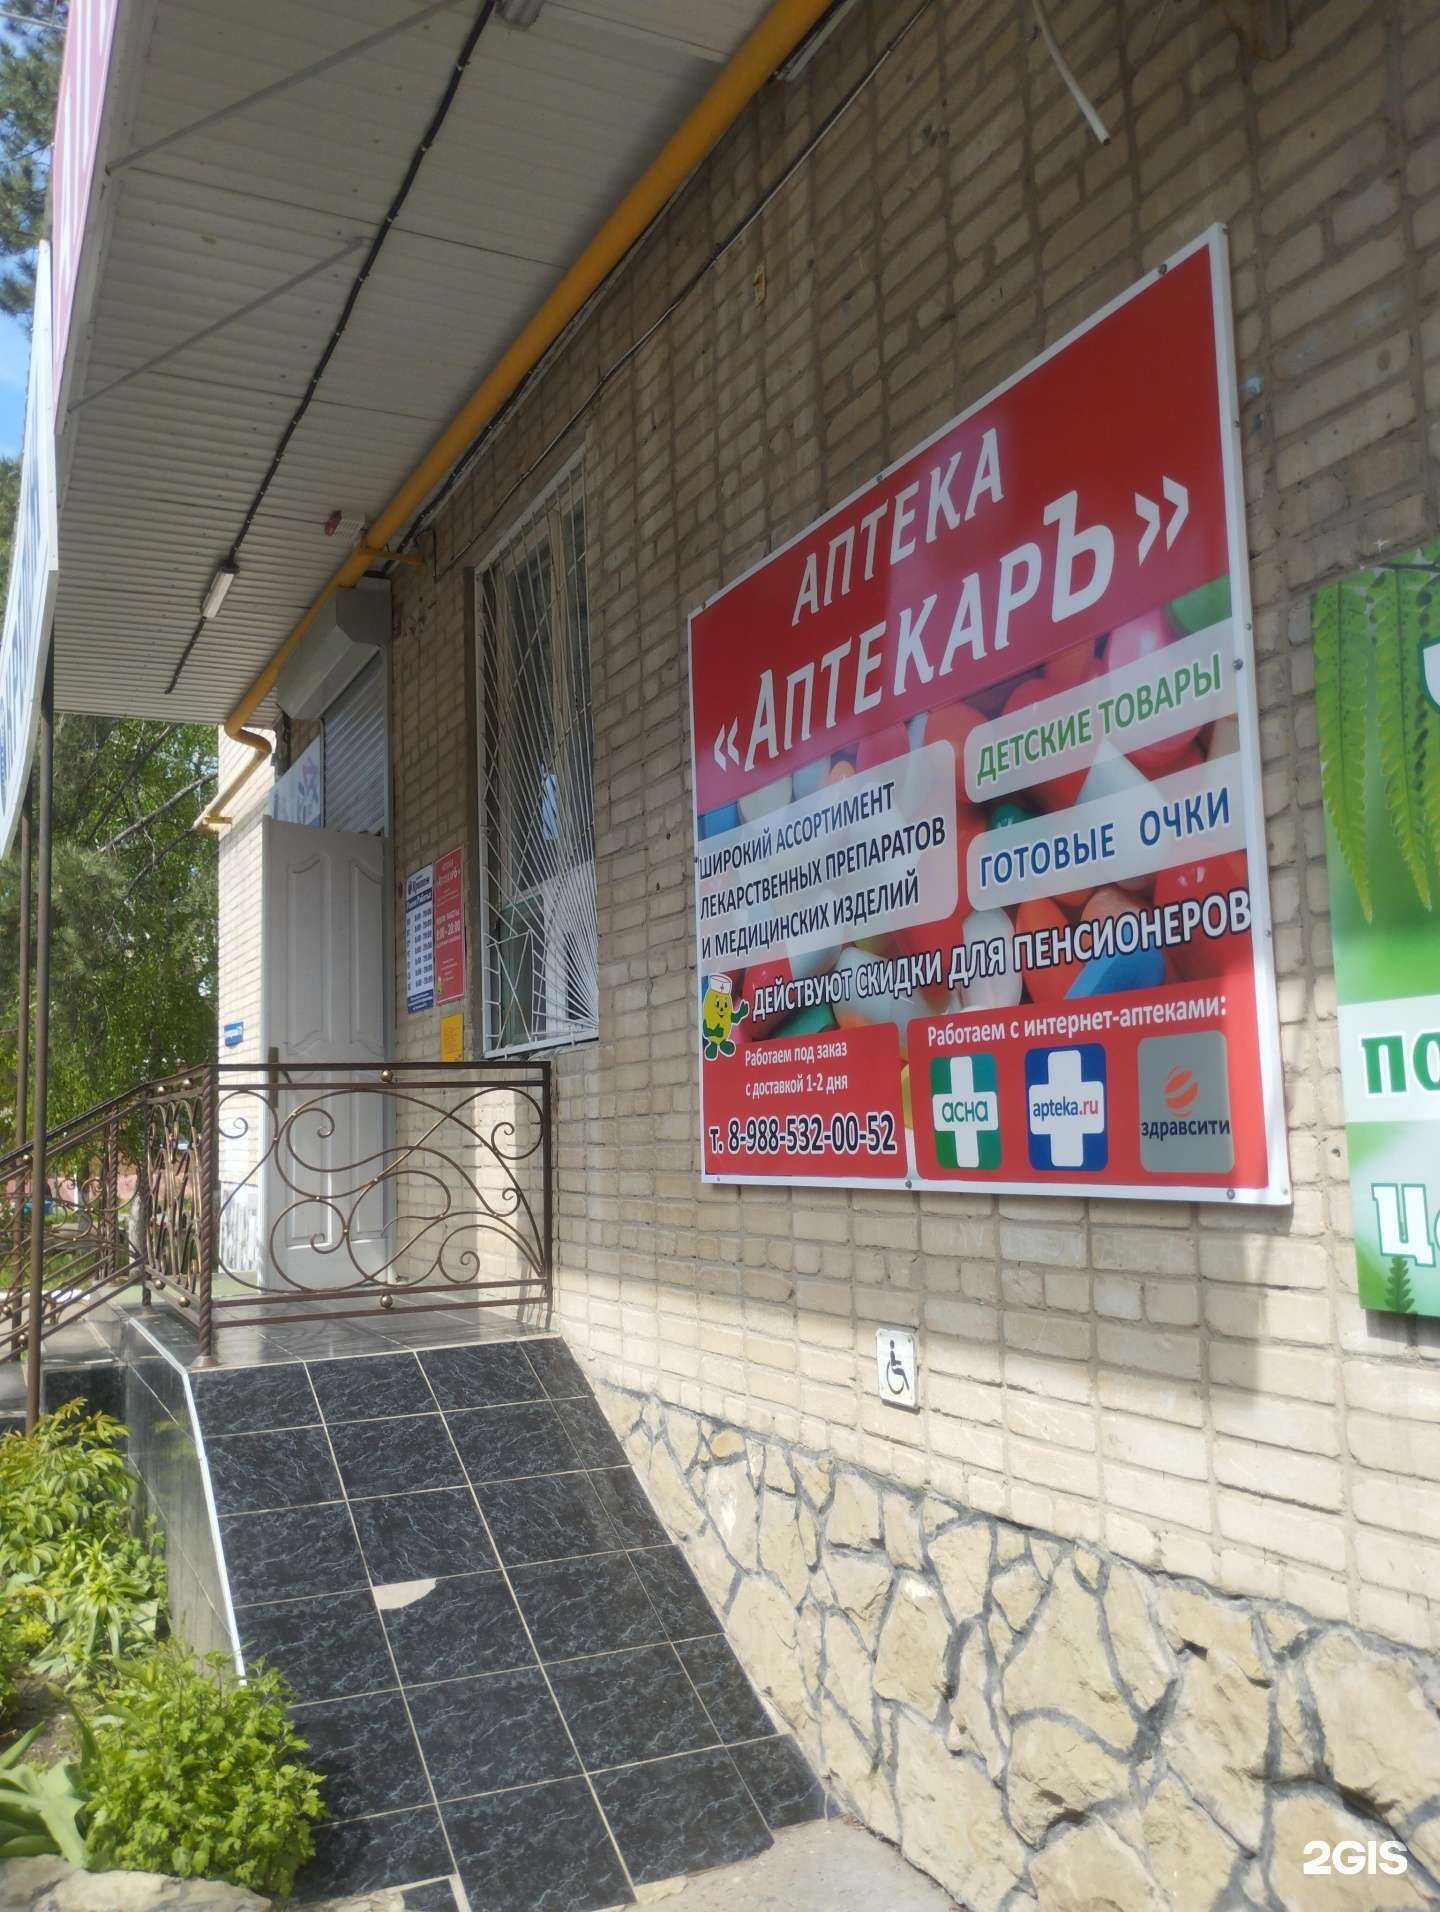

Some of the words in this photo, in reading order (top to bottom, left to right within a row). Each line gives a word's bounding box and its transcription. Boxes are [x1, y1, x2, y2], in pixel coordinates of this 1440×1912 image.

[791, 426, 1005, 627] АПТЕКА
[976, 708, 1093, 786] ДЕТСКИЕ
[1098, 653, 1221, 735] ТОВАРЫ
[699, 826, 773, 880] ШИРОКИЙ
[776, 781, 895, 853] АССОРТИМЕНТ
[979, 822, 1115, 889] ГОТОВЫЕ
[1139, 787, 1230, 847] ОЧКИ
[700, 858, 822, 920] ЛЕКАРСТВЕННЫХ
[825, 816, 946, 881] ПРЕПАРАТОВ
[702, 936, 712, 960] И
[715, 903, 830, 958] МЕДИЦИНСКИХ
[833, 868, 920, 930] ИЗДЕЛИЙ
[752, 968, 853, 1022] ДЕЙСТВУЮТ
[855, 949, 943, 998] СКИДКИ
[948, 937, 1006, 990] ДЛЯ
[1012, 888, 1252, 972] ПЕНСИОНЕРОВ
[745, 1047, 792, 1067] Работаем
[794, 1046, 814, 1063] под
[816, 1041, 848, 1058] заказ
[927, 1025, 1005, 1047] Работаем
[1010, 1022, 1020, 1039] с
[1024, 995, 1227, 1038] интернет-аптеками:
[745, 1084, 752, 1097] с
[752, 1075, 804, 1099] доставкой
[806, 1073, 824, 1092] 1-2
[826, 1075, 848, 1095] дня
[941, 1100, 989, 1123] асна
[1032, 1096, 1099, 1120] apteka.ru
[728, 1111, 897, 1155] 8-988-532-00-52
[1140, 1117, 1231, 1141] здравсити
